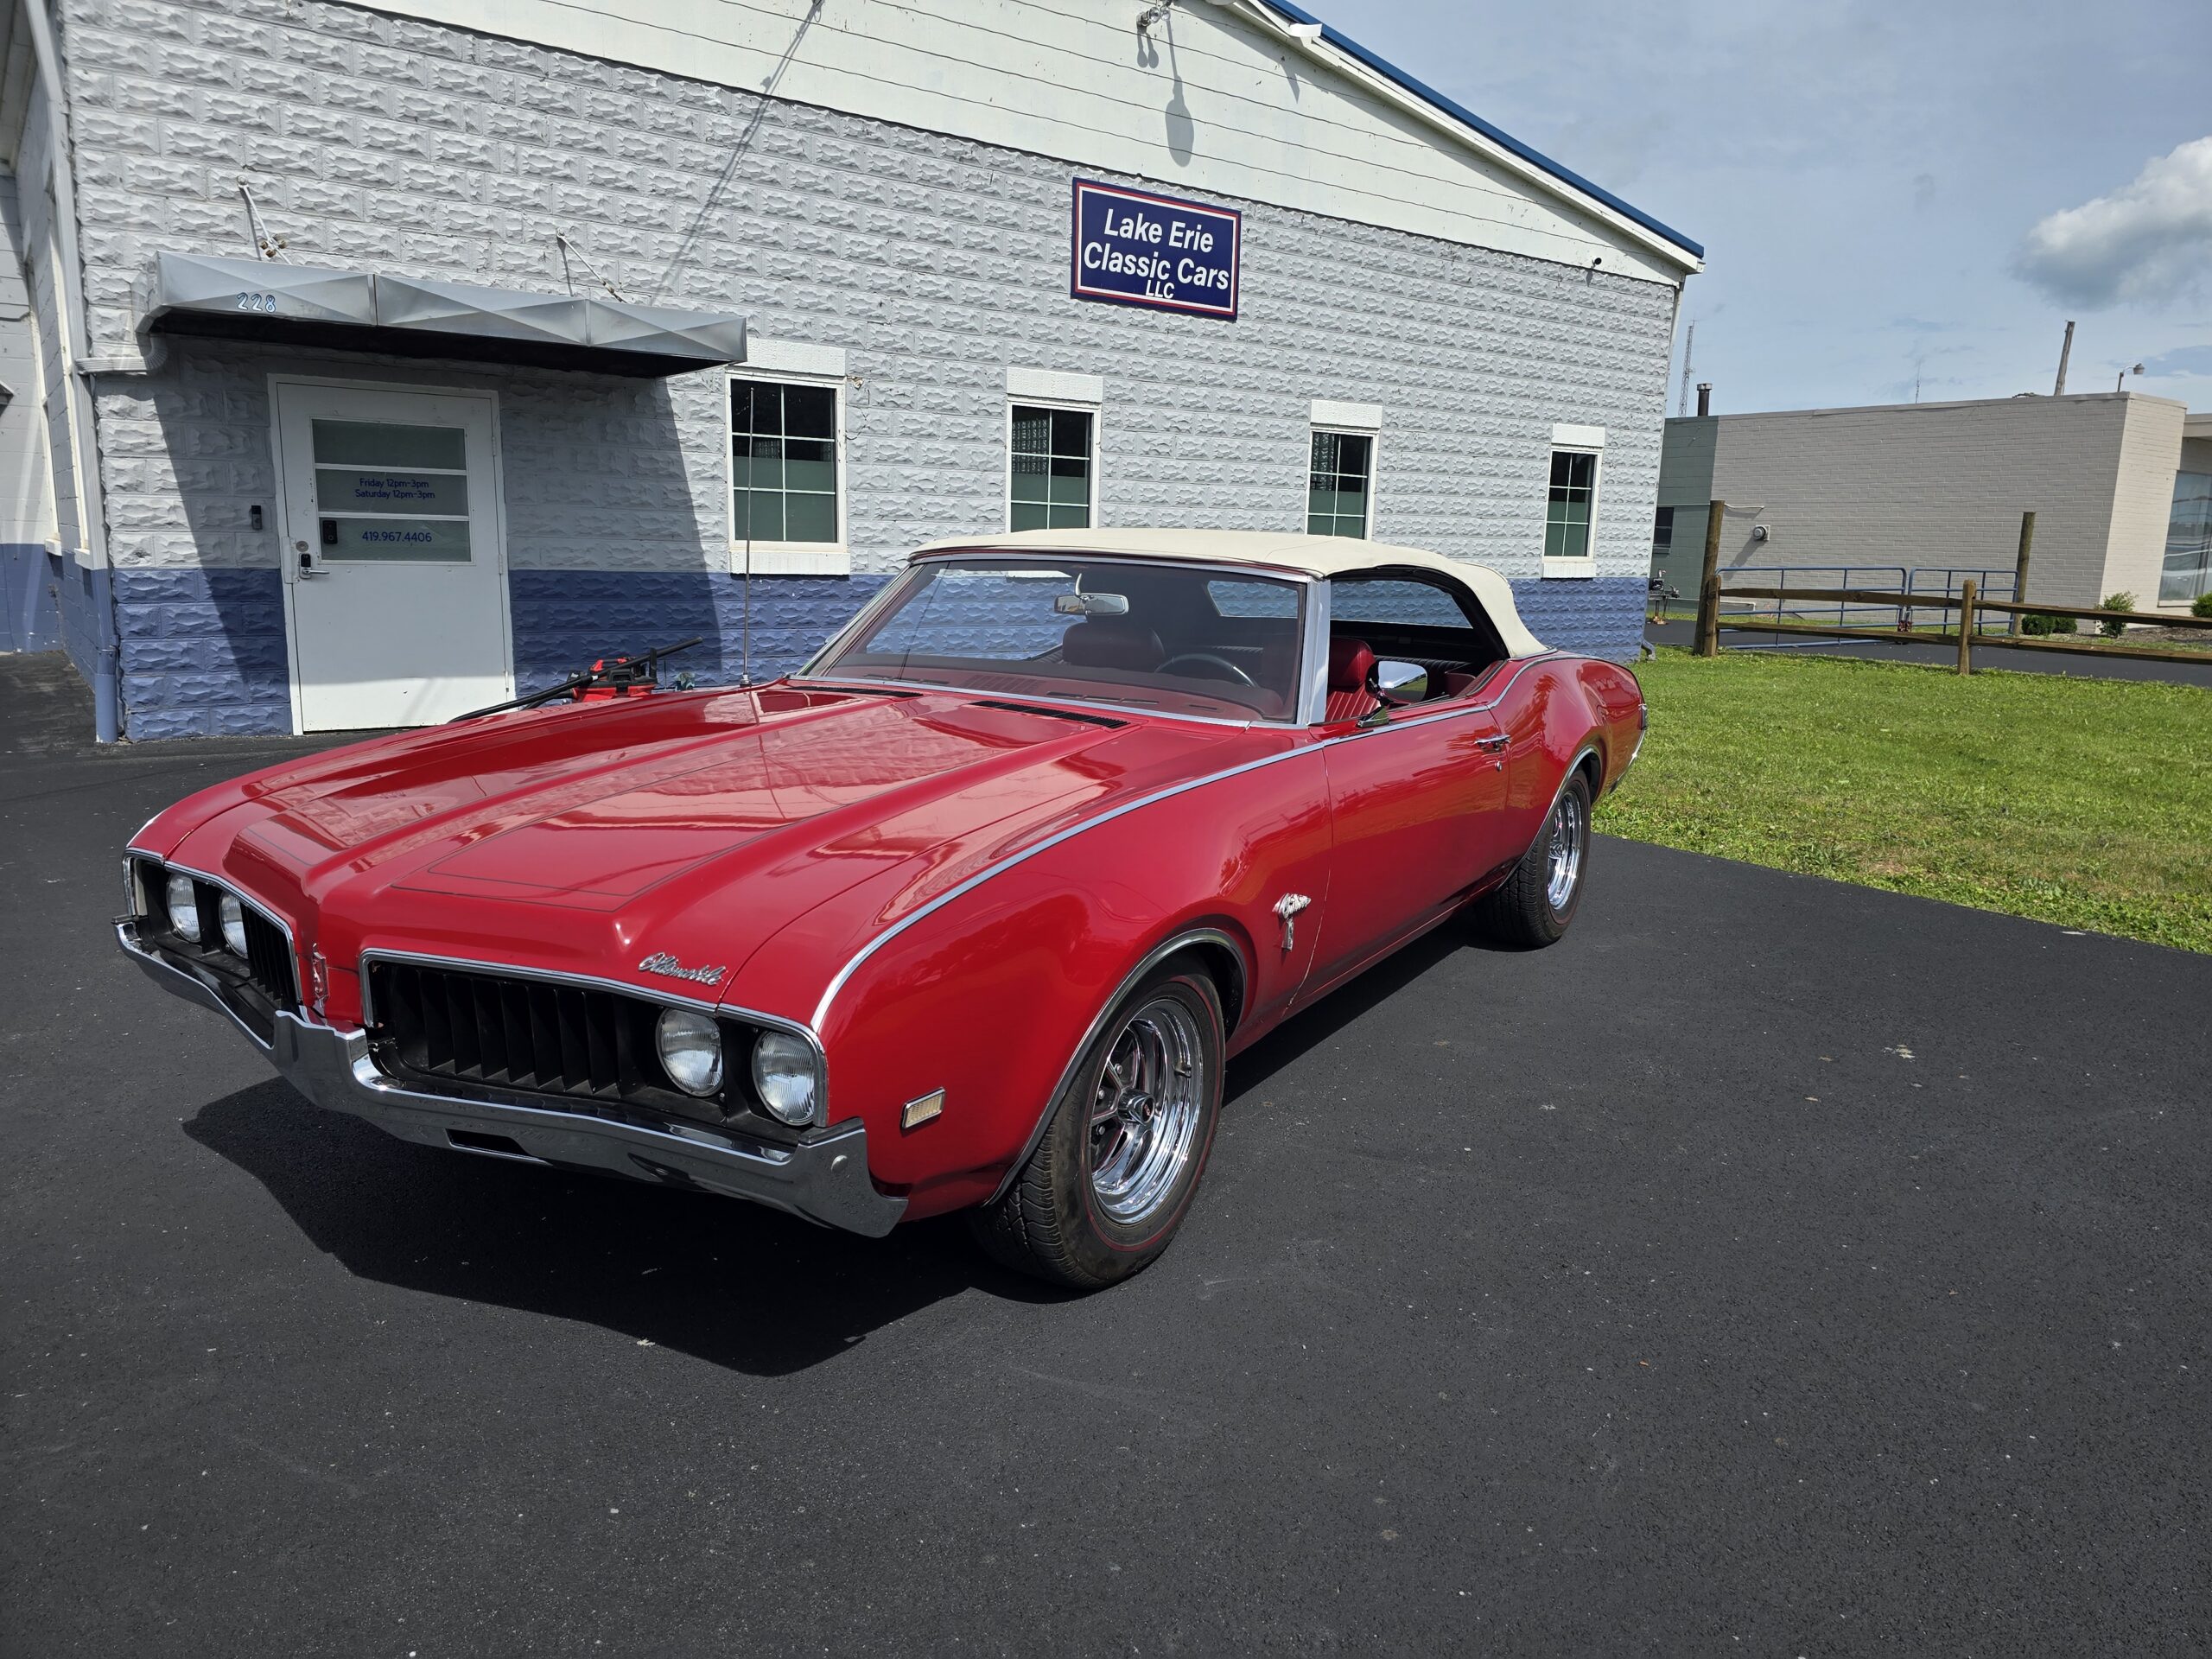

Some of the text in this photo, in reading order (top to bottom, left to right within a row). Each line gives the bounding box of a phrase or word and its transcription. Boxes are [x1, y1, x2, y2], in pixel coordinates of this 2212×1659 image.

[1103, 208, 1214, 253] Lake Erie
[1084, 241, 1230, 290] Classic Cars
[1145, 279, 1175, 299] LLC
[237, 292, 276, 313] 228
[359, 478, 429, 489] Friday 12pm-3pm
[355, 489, 435, 500] Saturday 12pm-3pm
[361, 531, 432, 543] 419.967.4406
